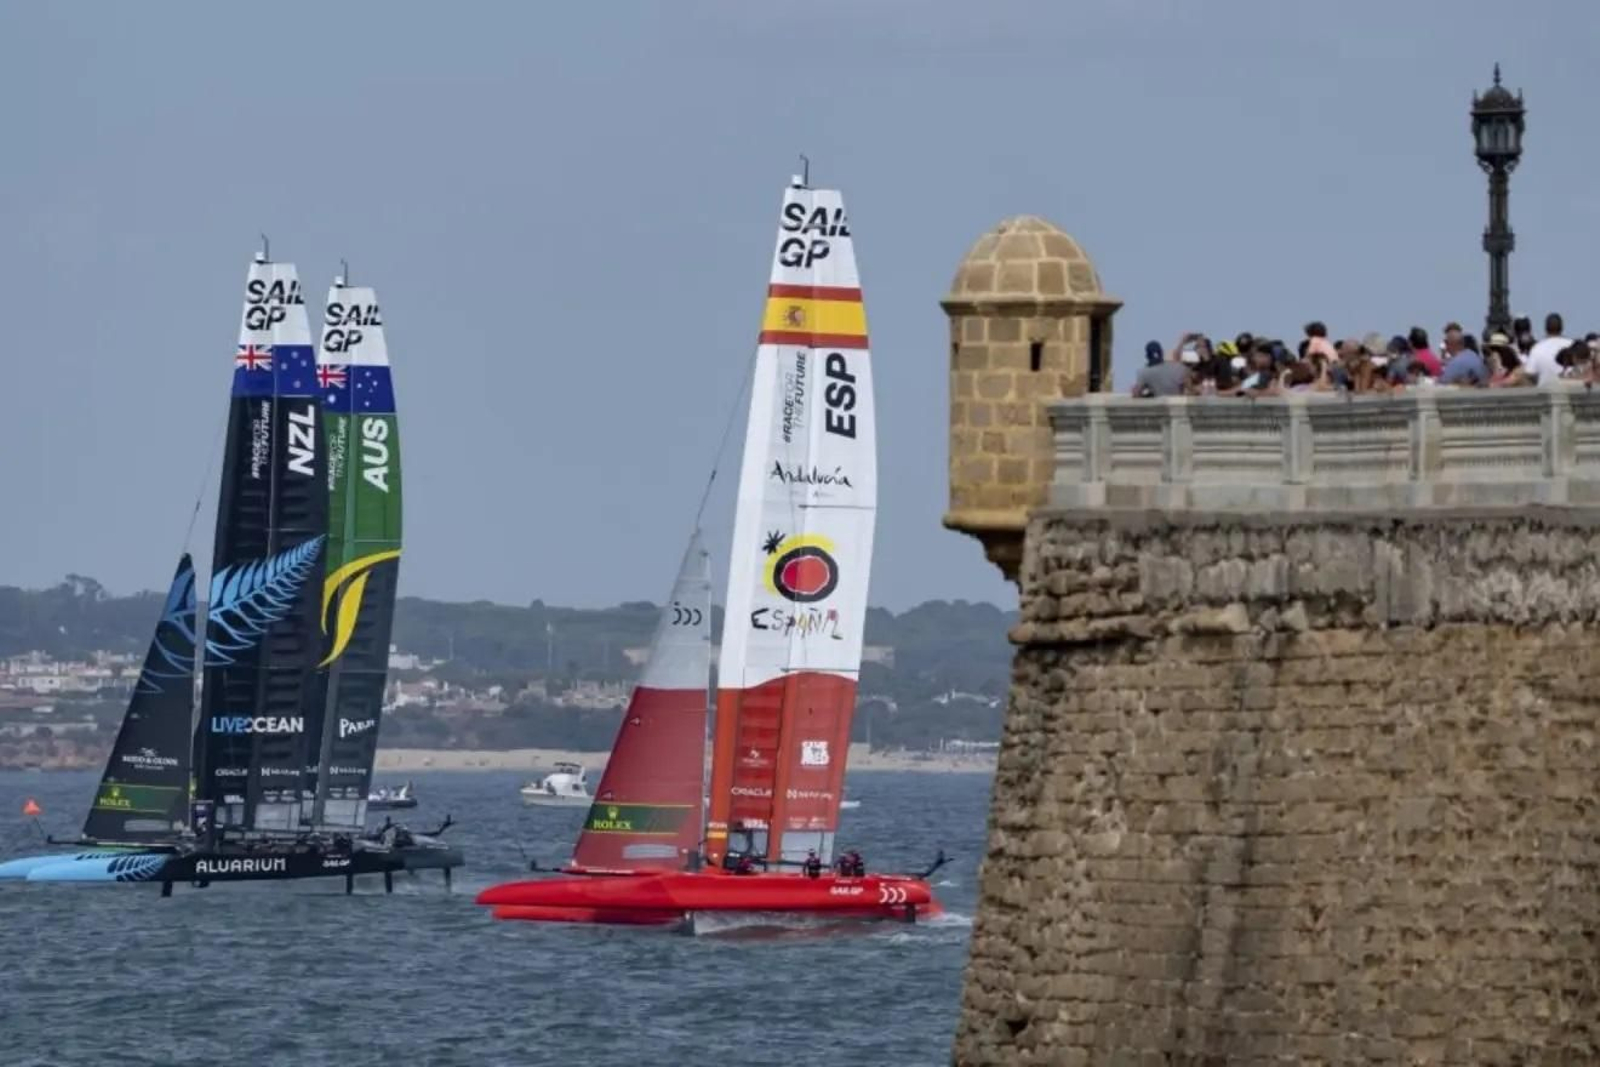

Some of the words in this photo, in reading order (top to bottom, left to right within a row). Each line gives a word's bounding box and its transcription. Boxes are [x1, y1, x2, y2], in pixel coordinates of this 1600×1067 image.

[782, 203, 851, 237] SAIL
[779, 238, 830, 268] GP
[246, 279, 305, 305] SAIL
[245, 306, 287, 331] GP
[324, 303, 383, 326] SAIL
[323, 329, 363, 353] GP
[825, 352, 857, 439] ESP
[288, 404, 315, 476] NZL
[362, 417, 389, 493] AUS
[731, 786, 772, 797] ORACLE
[593, 819, 632, 830] ROLEX
